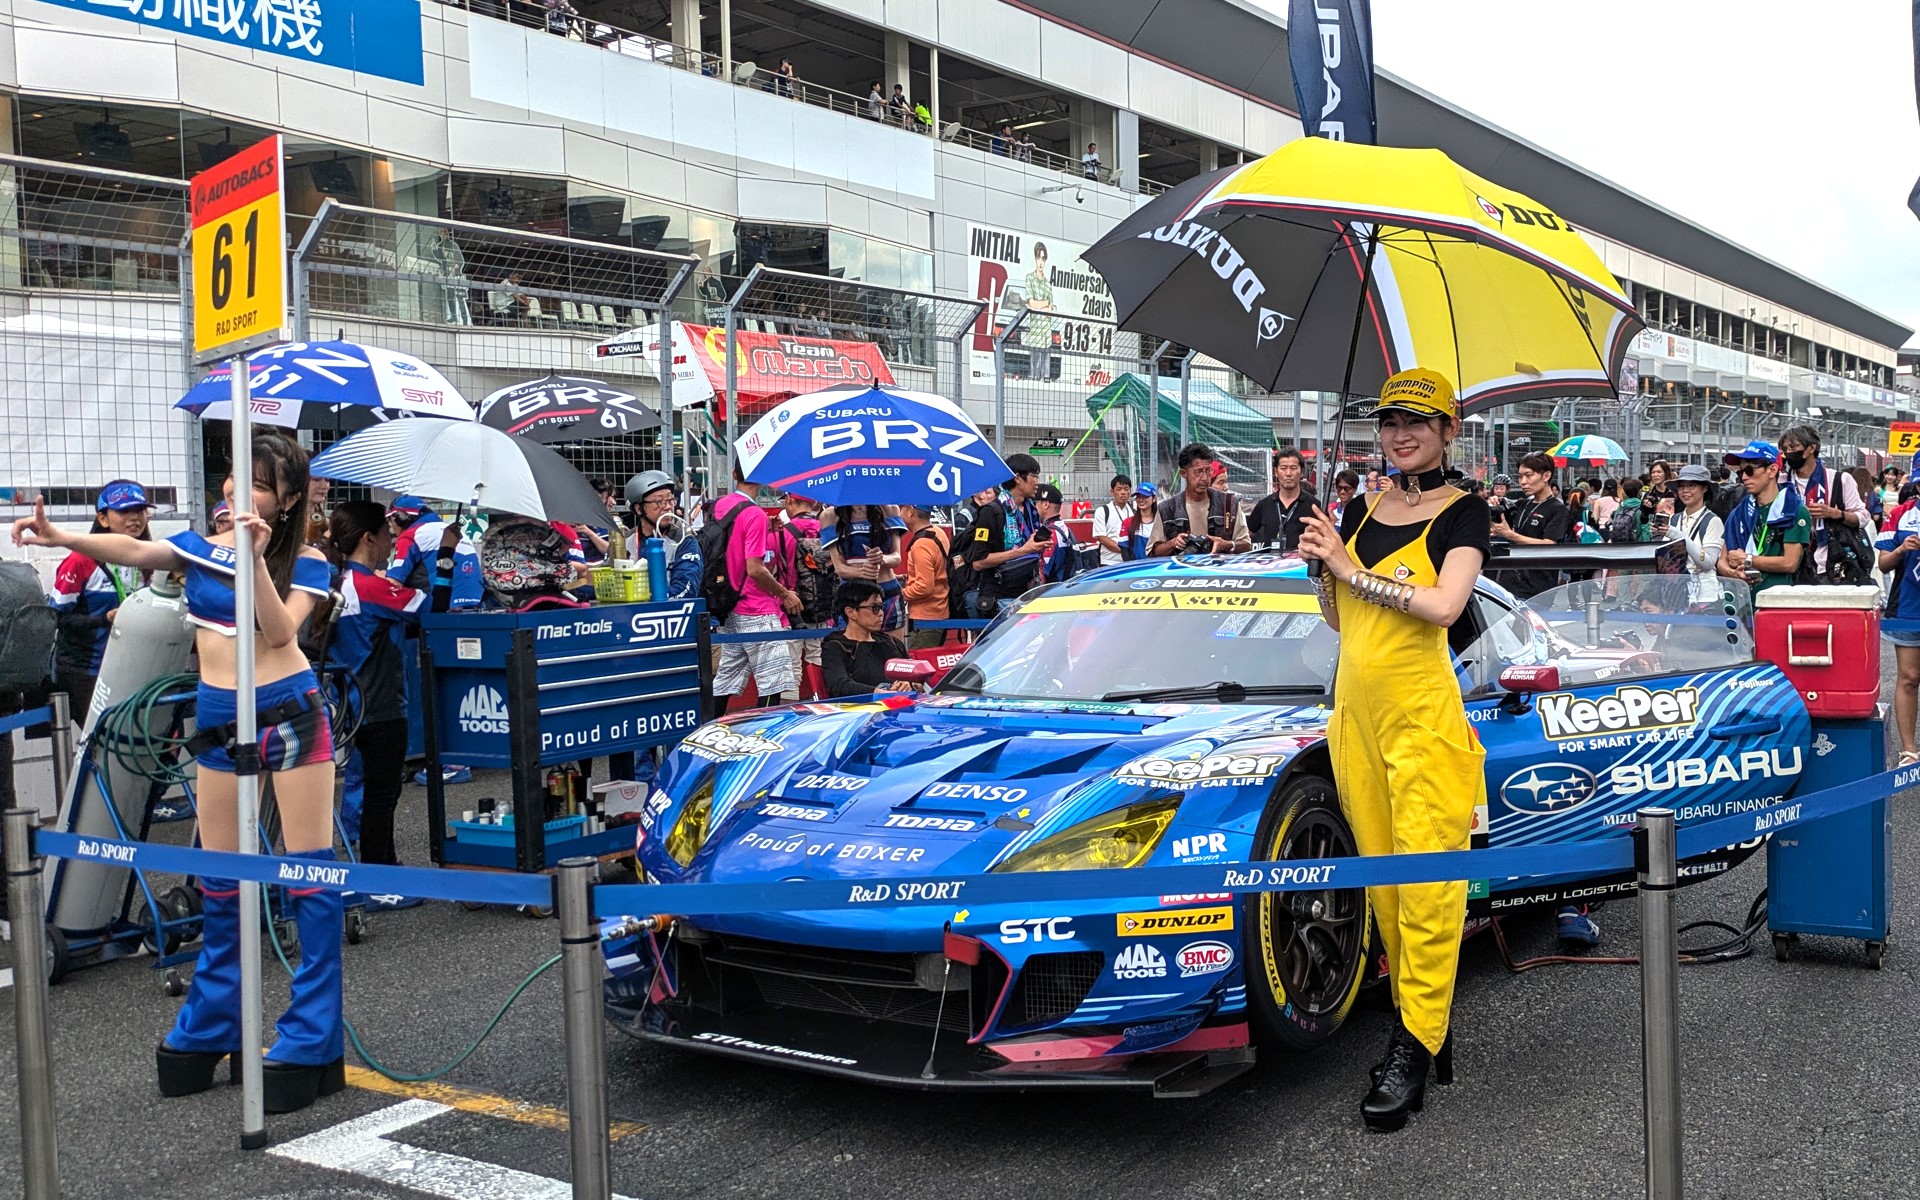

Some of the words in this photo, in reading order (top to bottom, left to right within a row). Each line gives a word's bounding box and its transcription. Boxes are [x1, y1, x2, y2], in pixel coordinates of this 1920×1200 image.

[207, 156, 274, 205] AUTOBACS
[970, 227, 1021, 264] INITIAL
[211, 208, 259, 310] 61
[1050, 265, 1111, 298] Anniversary
[1082, 294, 1112, 319] 2days
[216, 321, 231, 337] R&D
[233, 310, 258, 331] SPORT
[608, 342, 641, 354] YOKOHAMA
[780, 340, 835, 357] Team
[393, 371, 429, 380] SUBARU
[508, 382, 568, 398] SUBARU
[1387, 389, 1432, 399] DUNLOP
[508, 386, 643, 421] BRZ
[815, 407, 893, 420] SUBARU
[550, 415, 581, 424] BOXER
[600, 408, 628, 431] 61
[811, 419, 985, 467] BRZ
[1561, 444, 1579, 455] 52
[807, 471, 839, 488] Proud
[845, 468, 858, 476] of
[861, 467, 901, 477] BOXER
[926, 461, 963, 496] 61
[462, 560, 474, 572] 61
[491, 560, 516, 570] Arai
[1161, 579, 1256, 590] SUBARU
[1097, 595, 1162, 606] seven
[1186, 594, 1258, 607] seven
[537, 624, 571, 640] Mac
[574, 619, 613, 636] Tools
[629, 602, 695, 642] STI
[1739, 678, 1774, 689] Fujikura
[459, 684, 510, 720] MAC
[1540, 687, 1698, 736] KeePer
[1465, 707, 1501, 722] PORT
[459, 719, 510, 734] TOOLS
[542, 724, 601, 751] Proud
[610, 720, 629, 740] of
[637, 709, 697, 735] BOXER
[687, 725, 783, 754] KeePer
[1558, 742, 1585, 754] FOR
[1589, 735, 1632, 750] SMART
[1635, 731, 1663, 744] CAR
[1665, 729, 1695, 741] LIFE
[678, 744, 696, 754] FOR
[691, 748, 717, 761] SMART
[1116, 755, 1282, 780] KeePer
[1611, 746, 1803, 795] SUBARU
[794, 774, 871, 790] DENSO
[1117, 777, 1146, 786] FOR
[1149, 780, 1198, 791] SMART
[1200, 779, 1228, 788] CAR
[1231, 777, 1265, 786] LIFE
[1894, 772, 1908, 788] R&D
[649, 788, 672, 815] NPR
[925, 782, 1028, 803] DENSO
[1603, 813, 1637, 826] MIZU
[1674, 803, 1721, 821] UBARU
[1725, 796, 1783, 814] FINANCE
[1756, 816, 1773, 831] R&D
[1774, 804, 1802, 826] SPORT
[78, 840, 99, 856] R&D
[100, 843, 137, 862] SPORT
[739, 832, 804, 852] Proud
[806, 842, 834, 855] of
[837, 843, 926, 862] BOXER
[1172, 832, 1227, 858] NPR
[279, 863, 304, 879] R&D
[306, 866, 349, 885] SPORT
[1223, 869, 1263, 887] R&D
[1267, 865, 1336, 885] SPORT
[848, 885, 891, 902] R&D
[894, 881, 965, 901] SPORT
[1468, 882, 1482, 894] VE
[1491, 893, 1557, 909] SUBARU
[1563, 881, 1639, 899] LOGISTICS
[999, 916, 1076, 944] STC
[1141, 914, 1226, 929] DUNLOP
[1114, 943, 1167, 970] MAC
[1183, 948, 1227, 965] BMC
[1113, 968, 1168, 980] TOOLS
[1186, 965, 1206, 974] Air
[692, 1032, 736, 1045] STI
[734, 1040, 858, 1063] Performance
